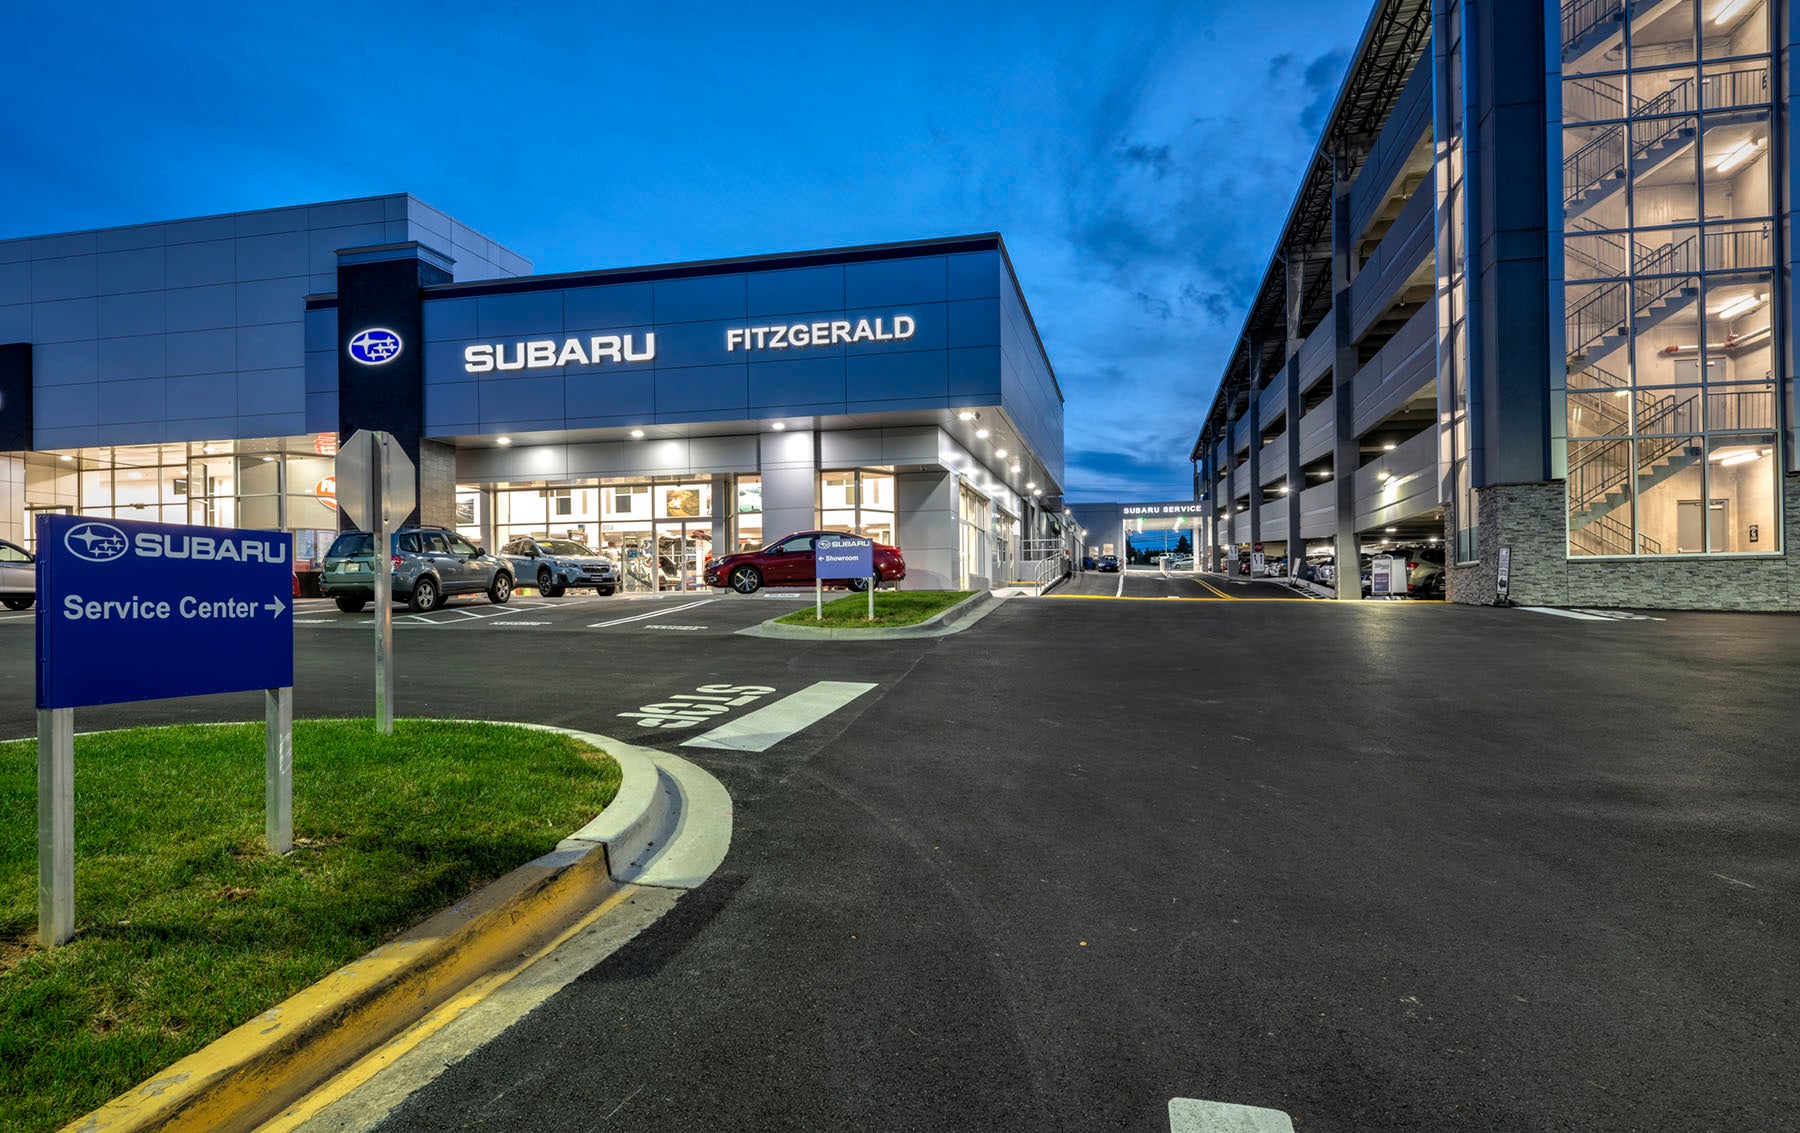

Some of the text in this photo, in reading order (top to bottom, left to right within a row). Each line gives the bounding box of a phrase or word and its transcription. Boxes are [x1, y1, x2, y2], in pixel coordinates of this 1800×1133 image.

[725, 315, 916, 351] FITZGERALD
[464, 332, 656, 373] SUBARU
[1162, 505, 1202, 513] SERVICE
[134, 532, 286, 564] SUBARU
[831, 540, 870, 548] SUBARU
[63, 594, 259, 620] Service Center
[616, 684, 777, 729] STOP
